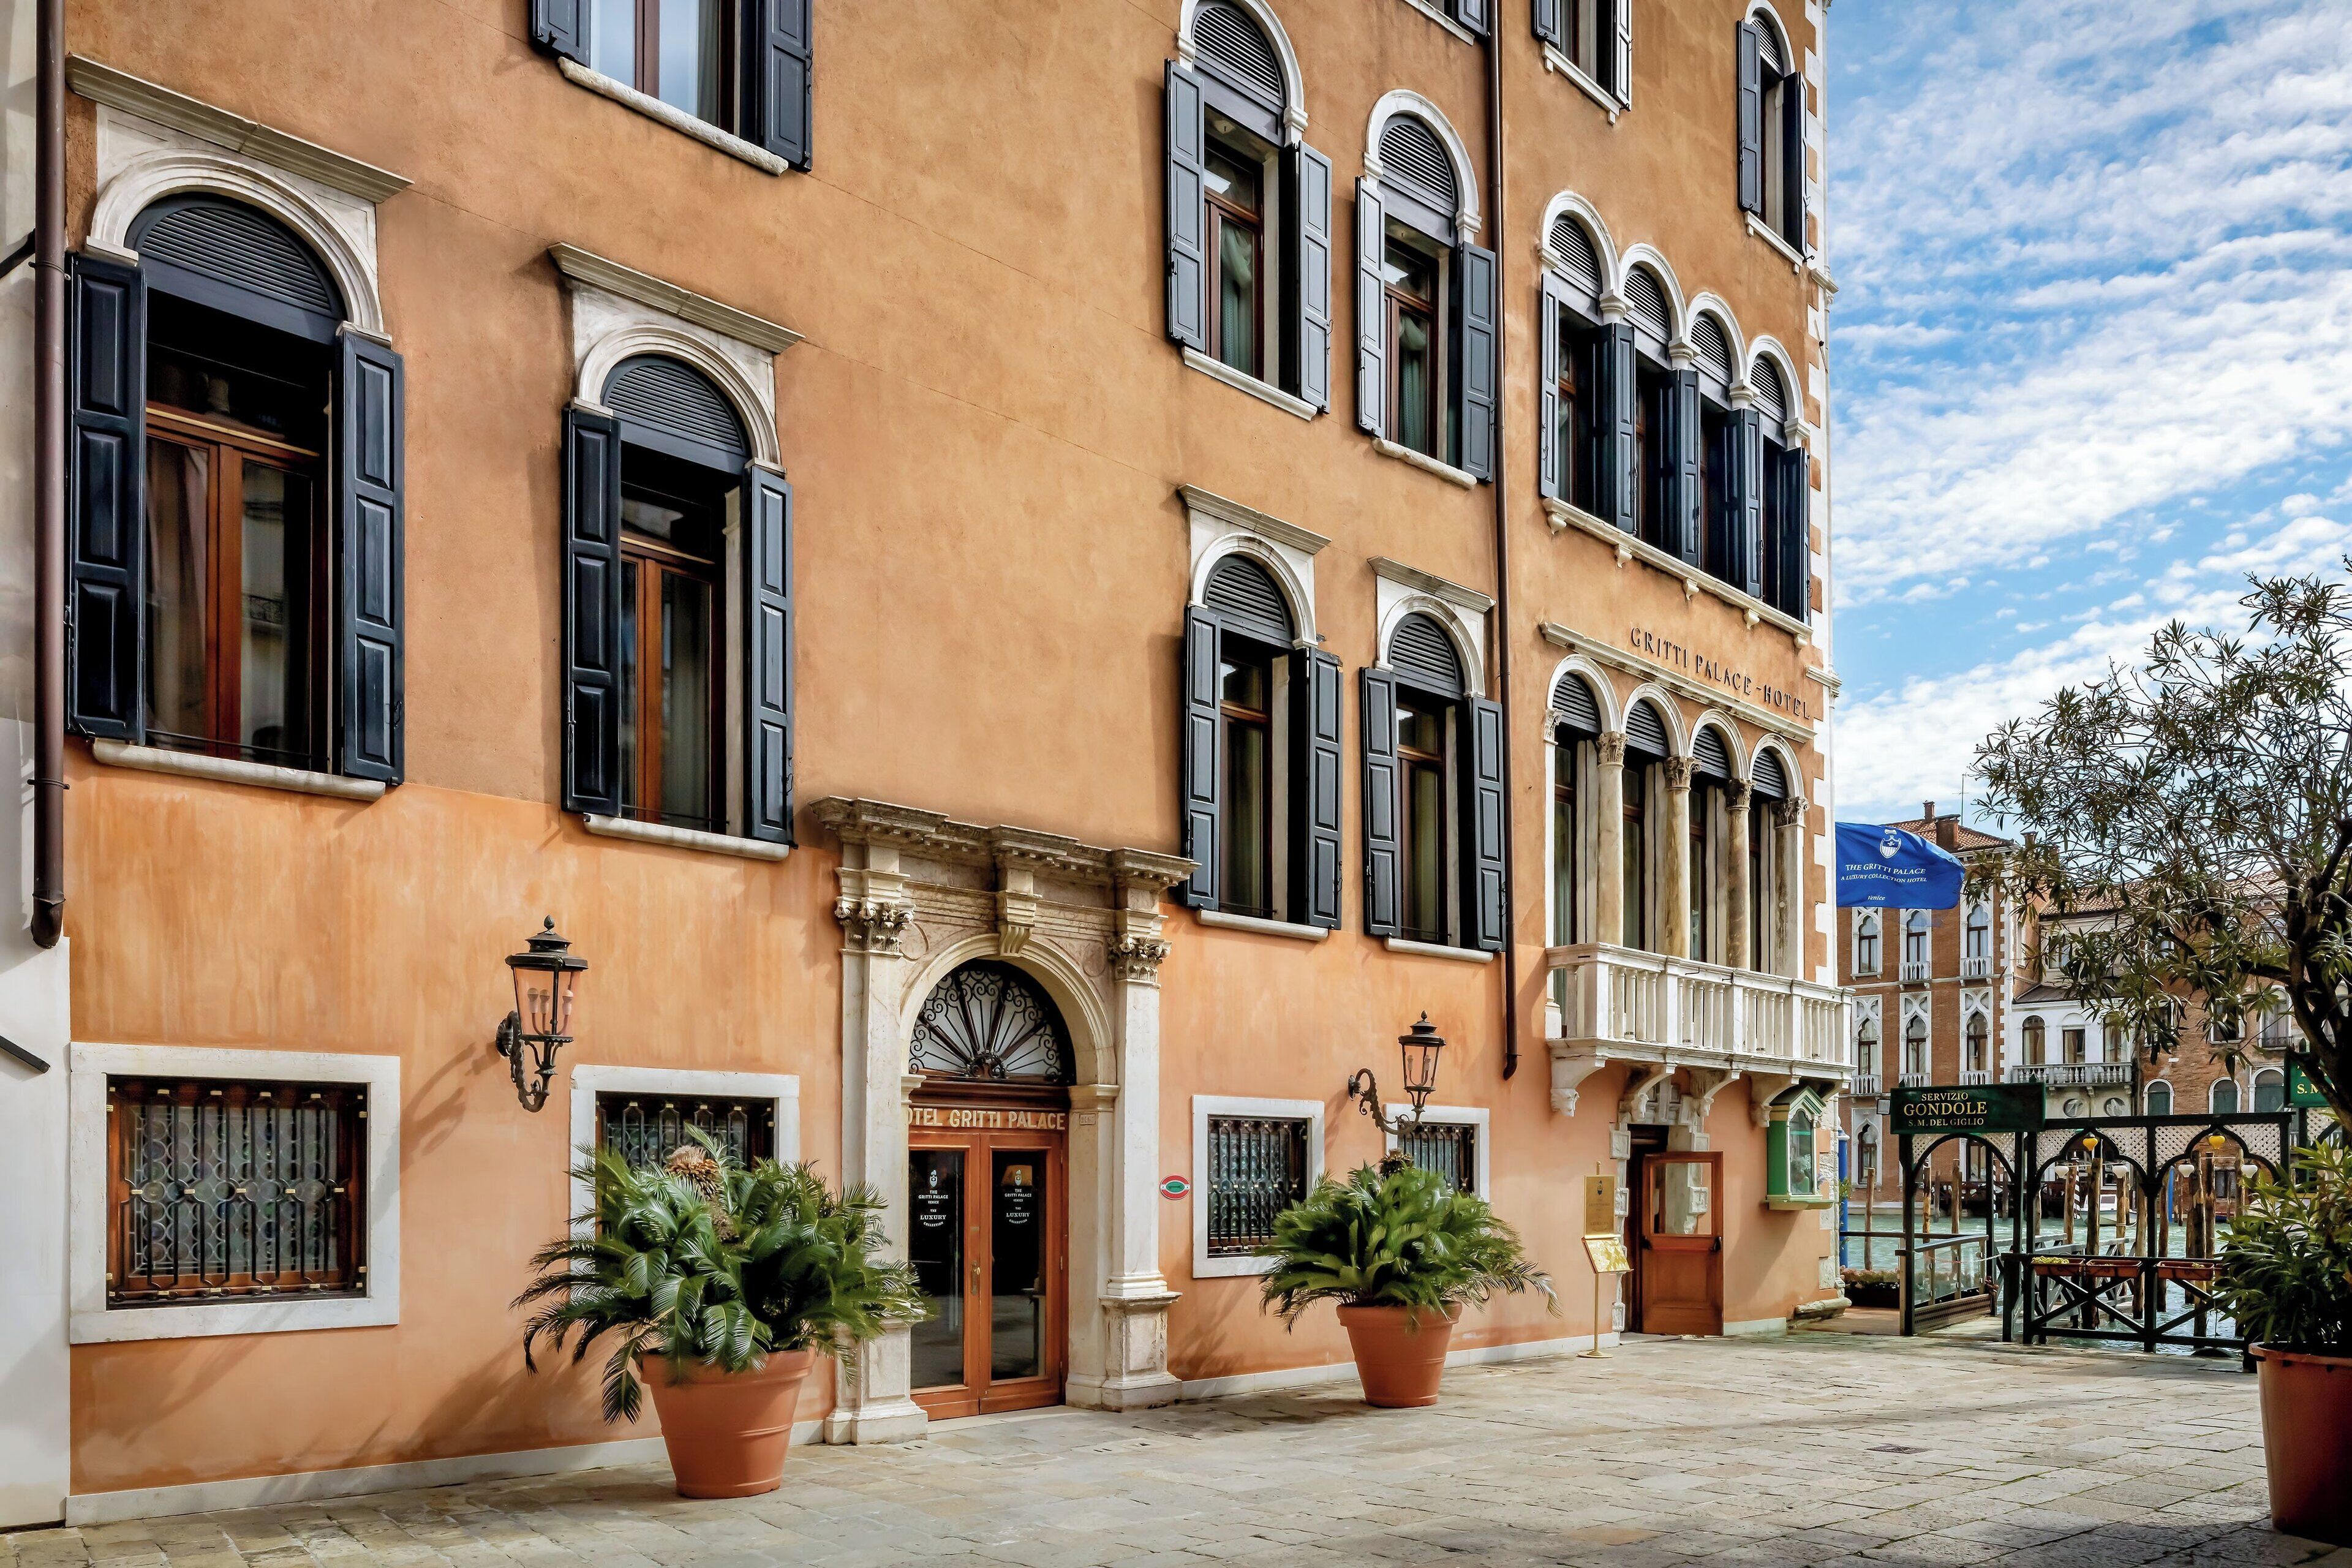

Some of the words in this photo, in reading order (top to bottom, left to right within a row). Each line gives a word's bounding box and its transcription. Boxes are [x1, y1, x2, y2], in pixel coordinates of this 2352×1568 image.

[1631, 627, 1688, 668] GRITTI
[1863, 863, 1891, 873] GRITTI
[1868, 873, 1906, 883] COLLECTION
[1921, 1092, 1969, 1101] SERVIZIO
[1903, 1101, 1988, 1116] GONDOLE
[907, 1107, 943, 1126] OTEL
[949, 1109, 1001, 1128] GRITTI
[1008, 1110, 1066, 1130] PALACE
